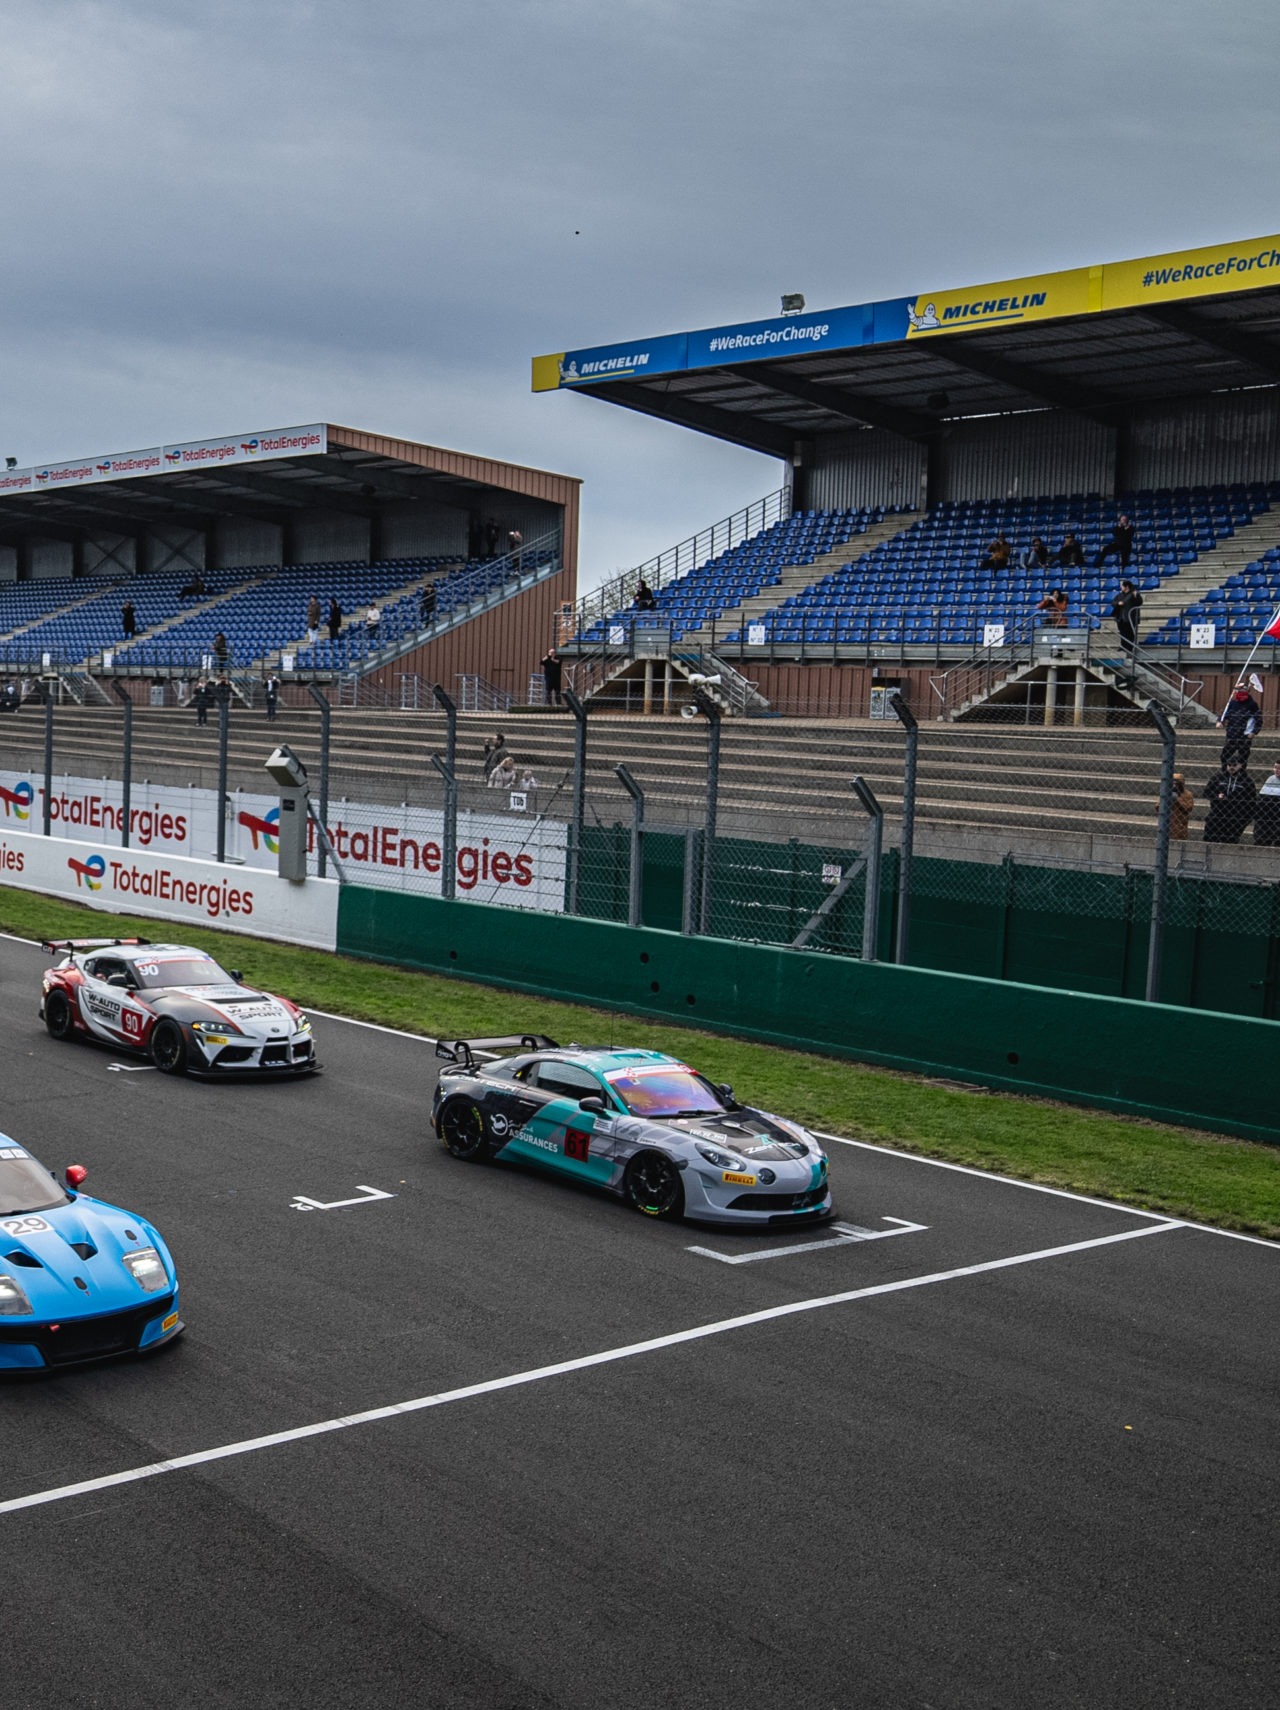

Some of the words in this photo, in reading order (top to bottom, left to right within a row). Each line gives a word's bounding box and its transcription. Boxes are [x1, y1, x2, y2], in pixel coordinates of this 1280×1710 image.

[942, 292, 1047, 320] MICHELIN
[709, 324, 829, 352] #WeRaceForChange
[580, 353, 650, 374] MICHELIN
[259, 433, 320, 452] TotalEnergies
[182, 446, 236, 463] TotalEnergies
[49, 466, 93, 481] TotalEnergies
[111, 456, 160, 474] TotalEnergies
[110, 861, 254, 917] TotalEnergies
[140, 965, 159, 976] 90
[89, 994, 120, 1011] W-AUTO
[90, 1005, 116, 1021] SPORT
[238, 1012, 283, 1020] SPORT
[126, 1013, 138, 1033] 90
[509, 1129, 558, 1153] ASSURANCES
[567, 1133, 587, 1158] 61
[725, 1174, 753, 1184] PIRELLI
[4, 1218, 48, 1235] 29
